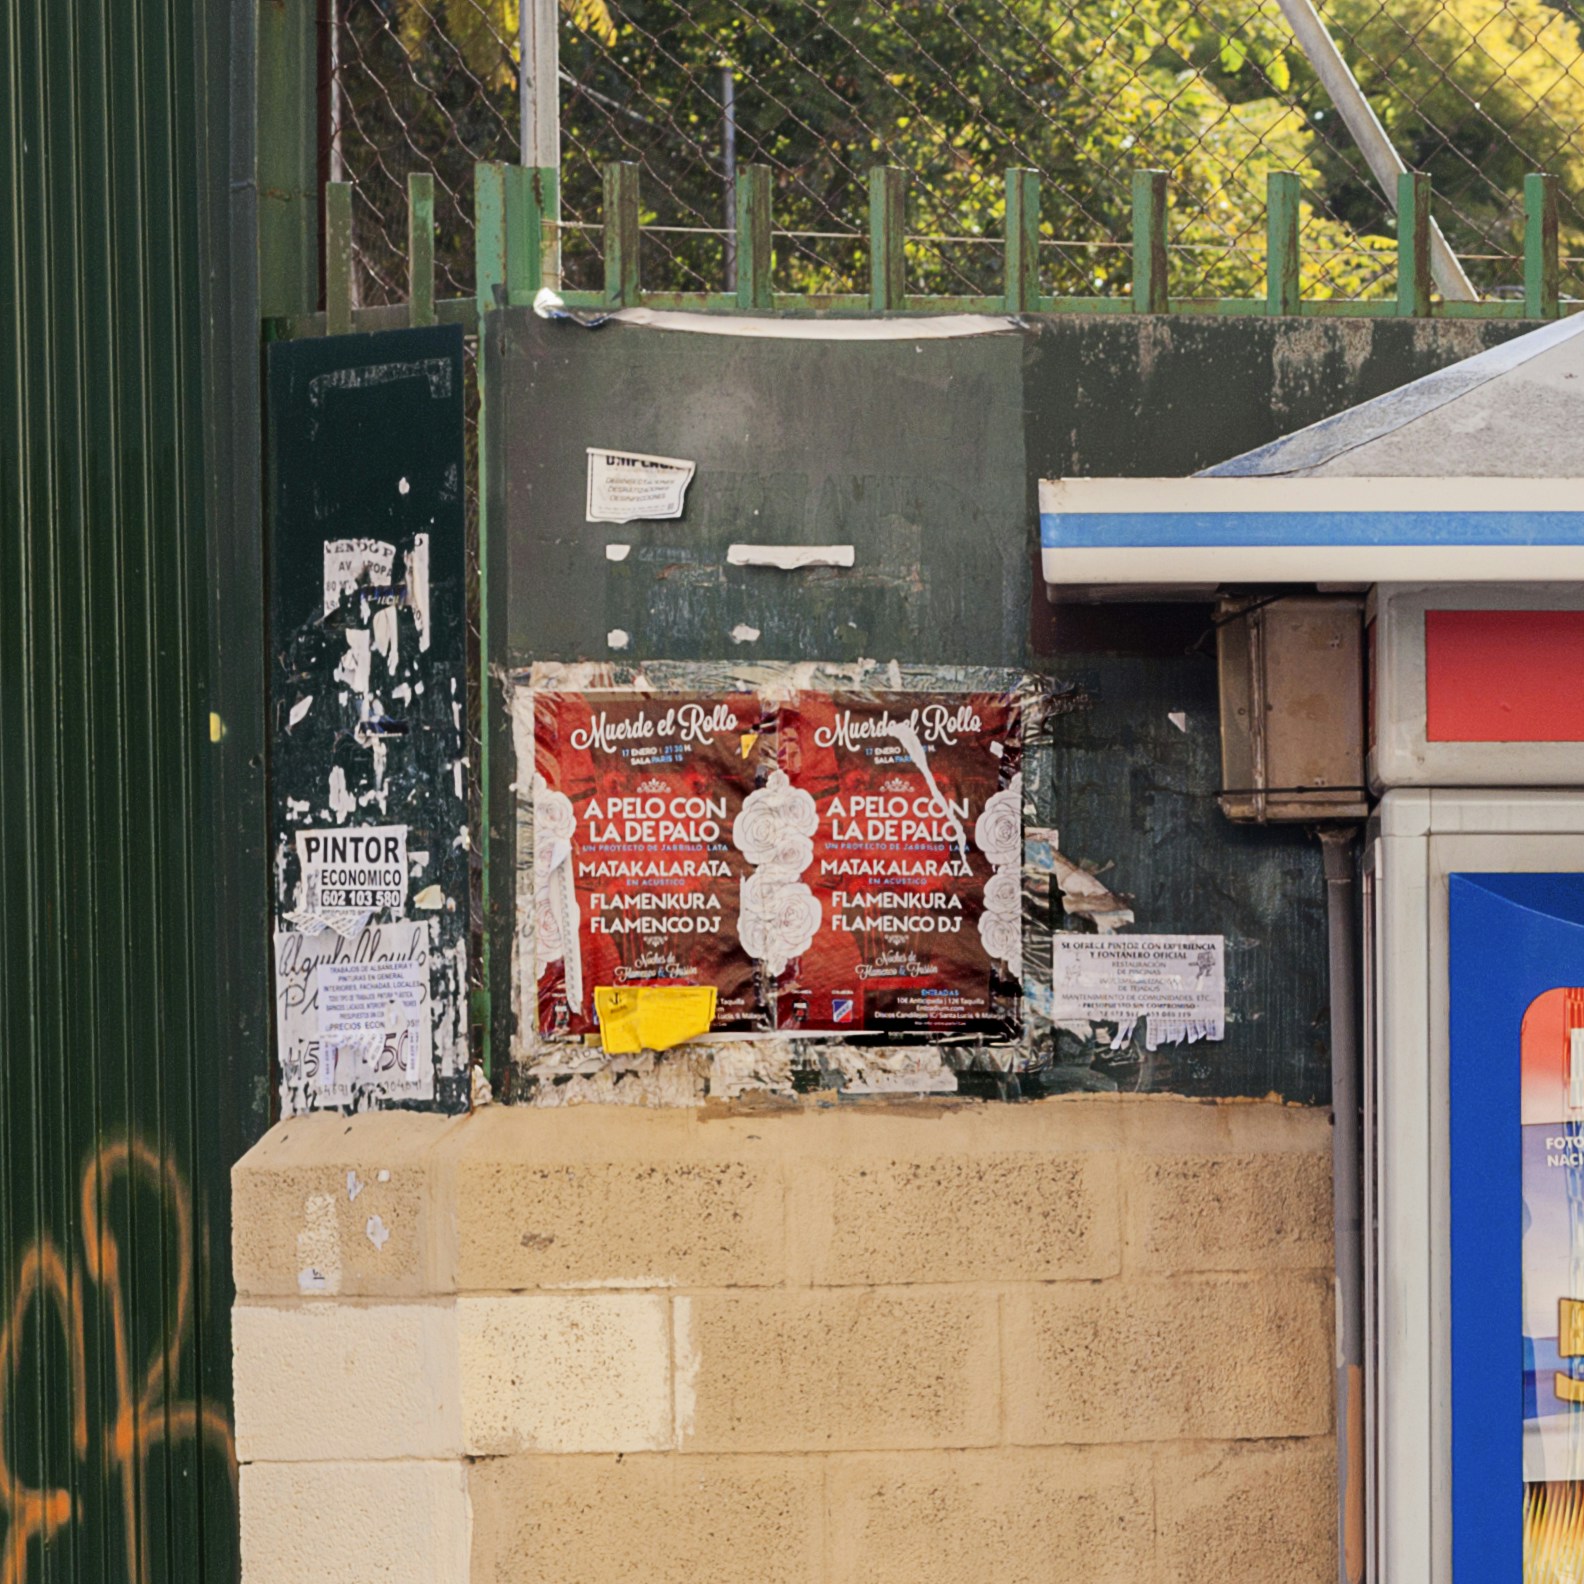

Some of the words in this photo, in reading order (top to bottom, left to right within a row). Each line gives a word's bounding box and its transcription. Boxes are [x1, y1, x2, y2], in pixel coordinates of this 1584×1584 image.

[571, 710, 654, 753] Muerde
[657, 709, 676, 736] el
[678, 704, 738, 745] Rollo
[922, 705, 982, 745] Rollo
[583, 798, 603, 819] A
[608, 797, 665, 819] PELO
[670, 797, 726, 819] CON
[826, 796, 846, 817] A
[851, 796, 908, 817] PELO
[912, 798, 969, 819] CON
[589, 821, 621, 842] LA
[625, 821, 656, 842] DE
[659, 821, 720, 842] PALO
[832, 820, 863, 841] LA
[868, 820, 899, 841] DE
[902, 820, 961, 842] PALO
[305, 837, 400, 863] PINTOR
[579, 861, 732, 877] MATAKALARATA
[821, 859, 973, 877] MATAKALARATA
[321, 869, 401, 886] ECONOMICO
[323, 891, 346, 906] 602
[350, 890, 372, 906] 103
[376, 891, 400, 906] 580
[590, 894, 721, 910] FLAMENKURA
[831, 891, 962, 910] FLAMENKURA
[590, 917, 693, 933] FLAMENCO
[697, 917, 721, 933] DJ
[832, 915, 934, 932] FLAMENCO
[938, 917, 962, 932] DJ
[1142, 942, 1160, 950] CON
[377, 972, 403, 980] GENERAL
